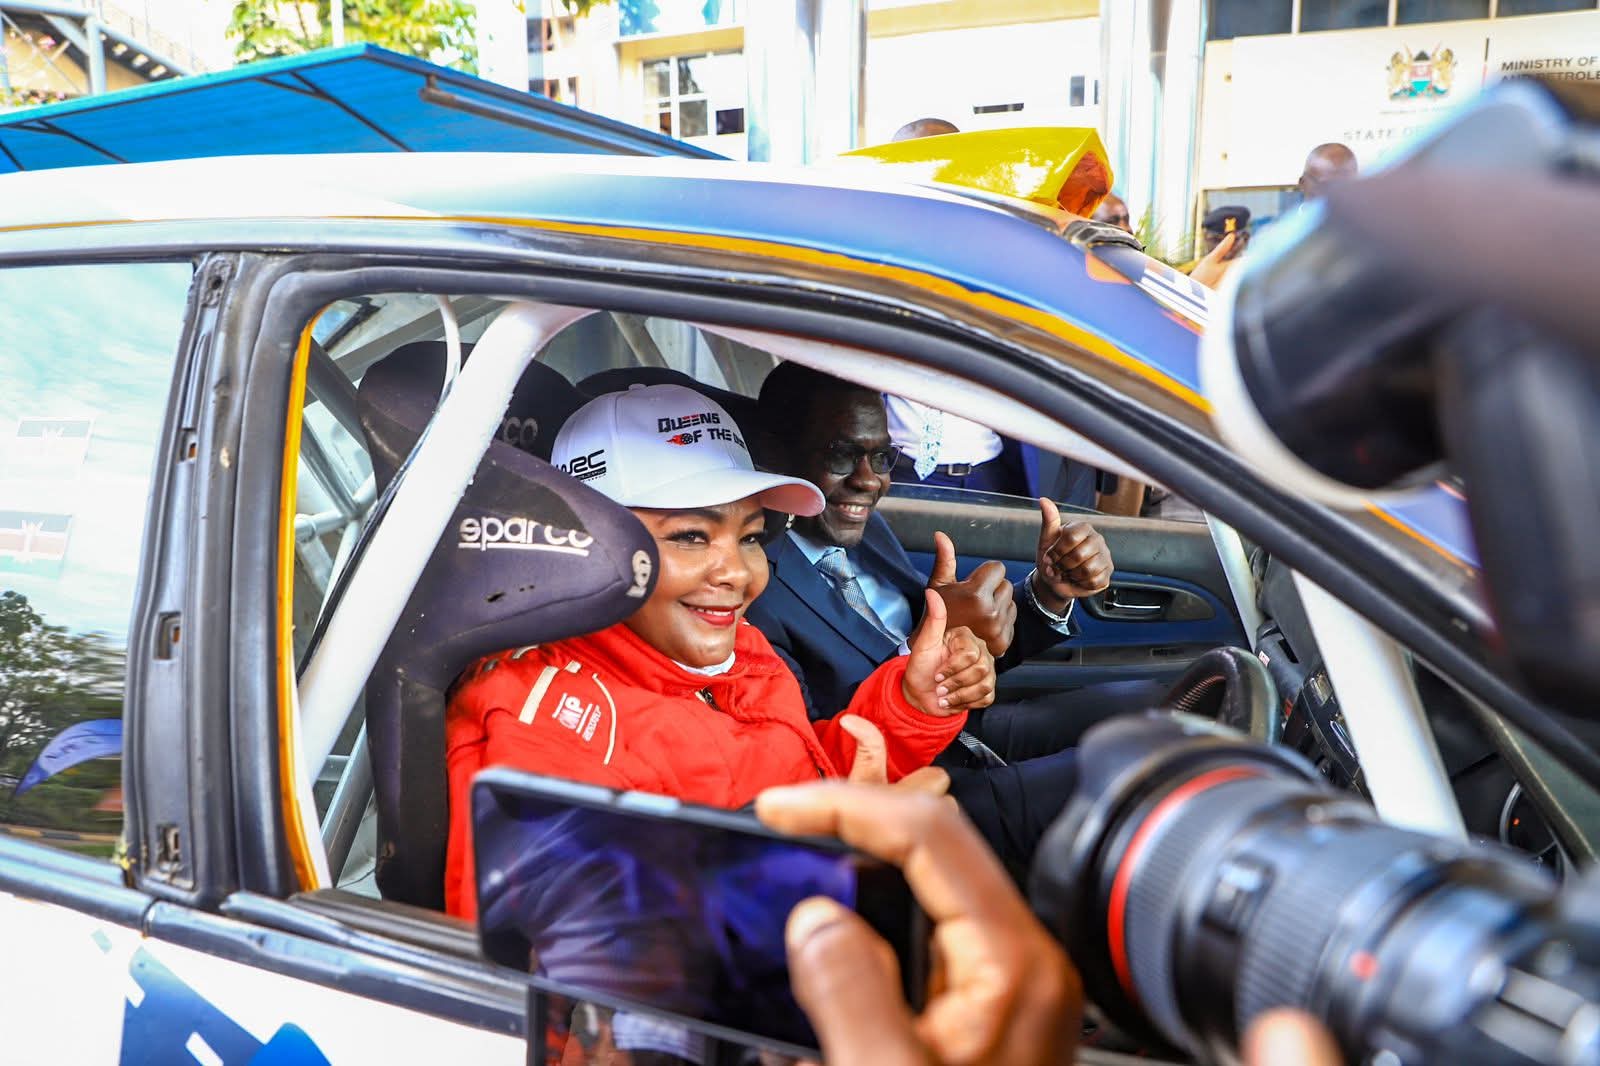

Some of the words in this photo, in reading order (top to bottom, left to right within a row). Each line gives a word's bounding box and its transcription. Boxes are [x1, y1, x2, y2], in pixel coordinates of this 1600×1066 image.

[1501, 58, 1574, 70] MINISTRY
[1577, 56, 1598, 66] OF
[657, 413, 721, 433] QUEENS
[707, 428, 732, 441] THE
